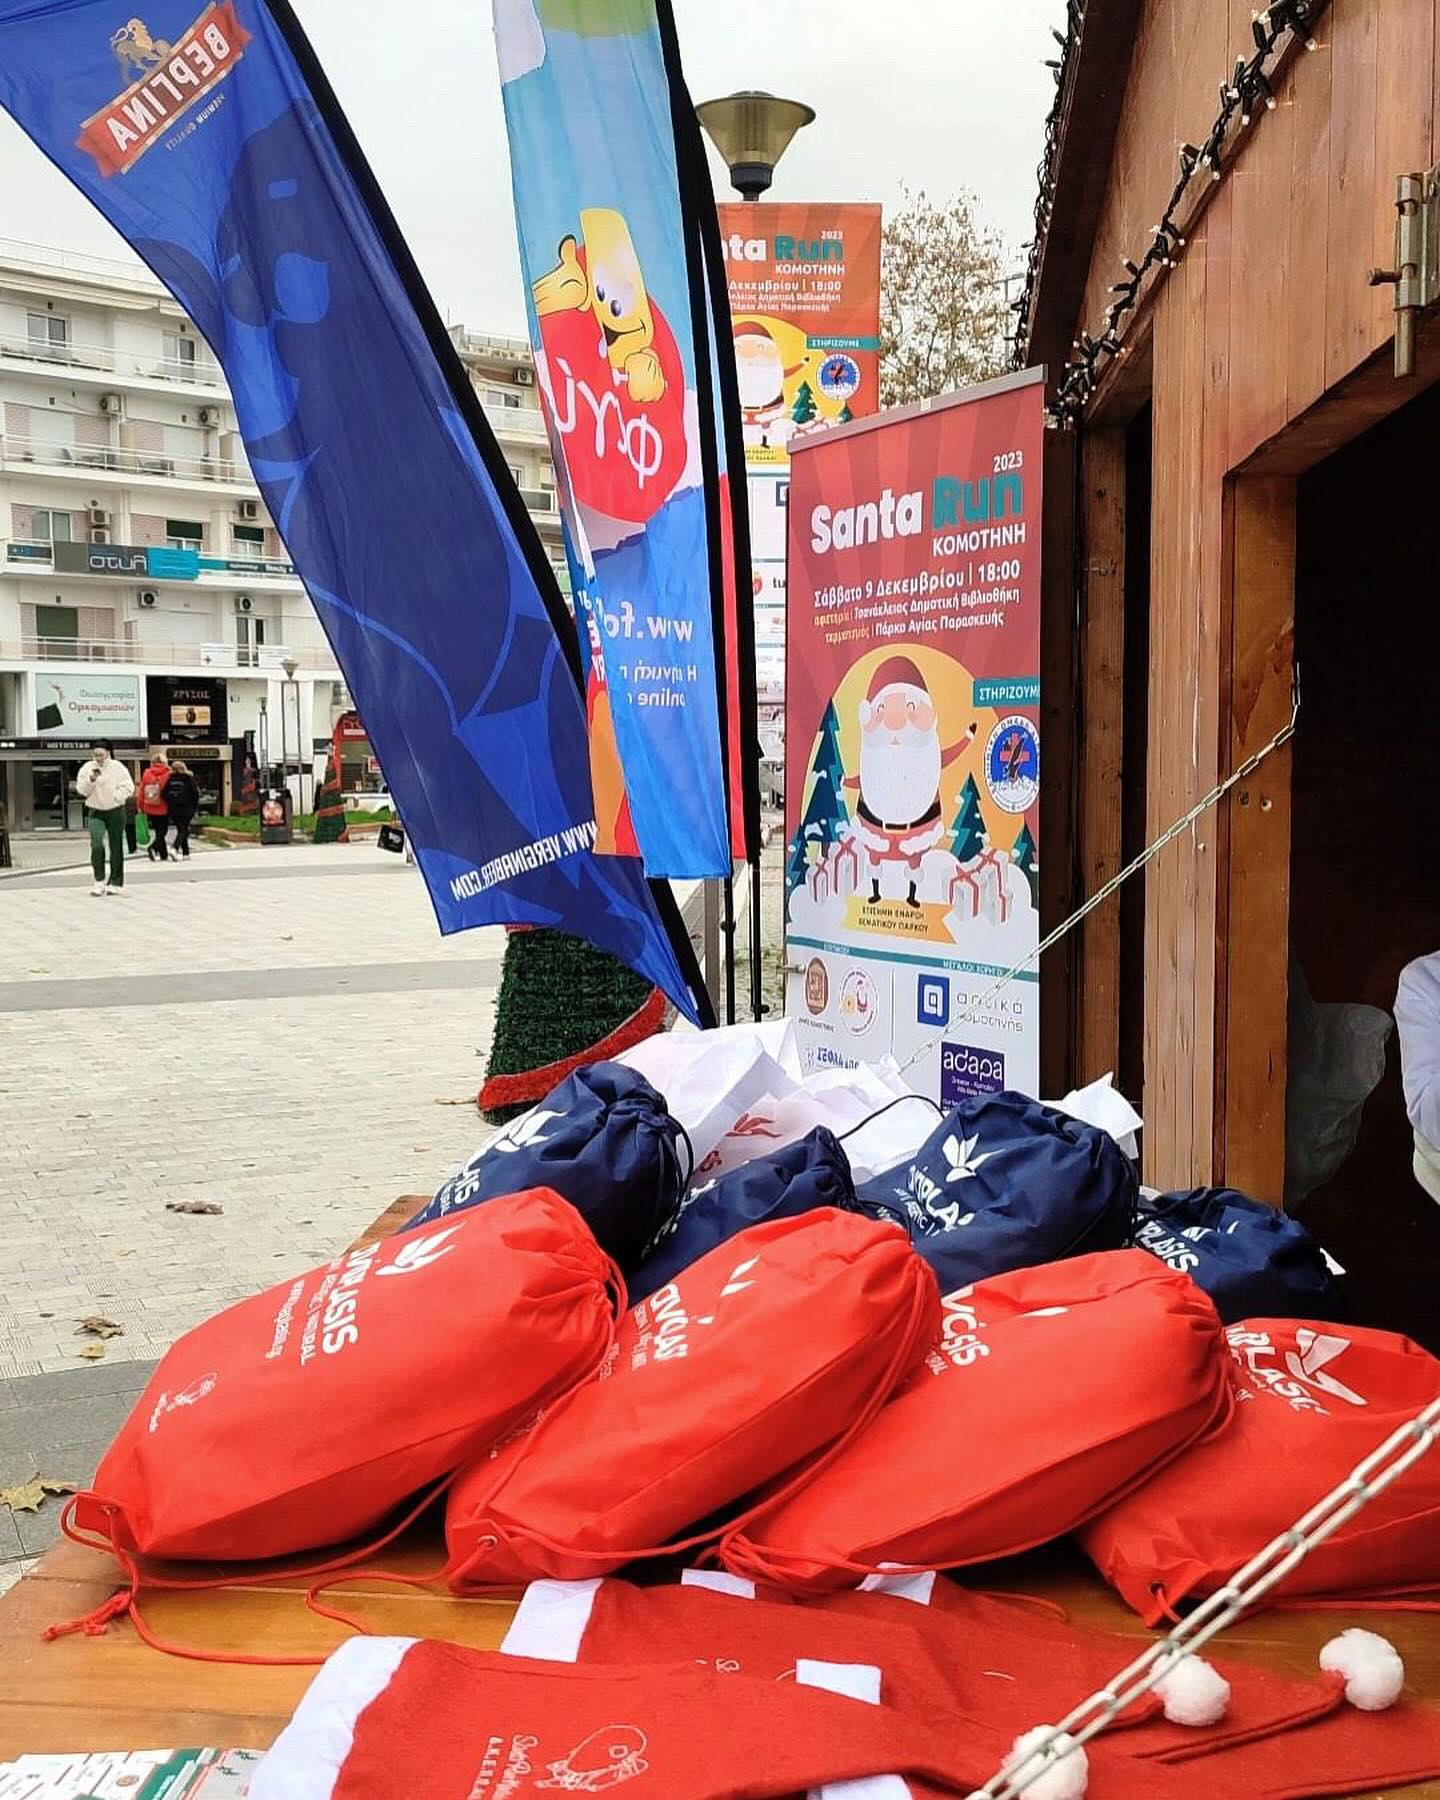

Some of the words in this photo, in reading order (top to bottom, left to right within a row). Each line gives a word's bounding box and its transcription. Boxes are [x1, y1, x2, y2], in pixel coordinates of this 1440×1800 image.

[774, 235, 844, 261] Run
[820, 230, 844, 240] 2023
[775, 264, 845, 275] ΚΟΜΟΤΗΝΗ
[993, 450, 1024, 473] 2023
[811, 488, 924, 555] Santa
[932, 472, 1024, 530] Run
[932, 522, 1027, 557] ΚΟΜΟΤΗΝΗ
[814, 585, 863, 610] Σάββατο
[865, 581, 873, 599] 9
[876, 568, 965, 598] Δεκεμβρίου
[978, 559, 1020, 583] 18:00
[910, 594, 960, 613] Δημοτική
[961, 588, 1020, 608] Βιβλιοθήκη
[875, 620, 907, 638] Πάρκο
[908, 617, 938, 635] Αγίας
[940, 610, 1004, 630] Παρασκευής
